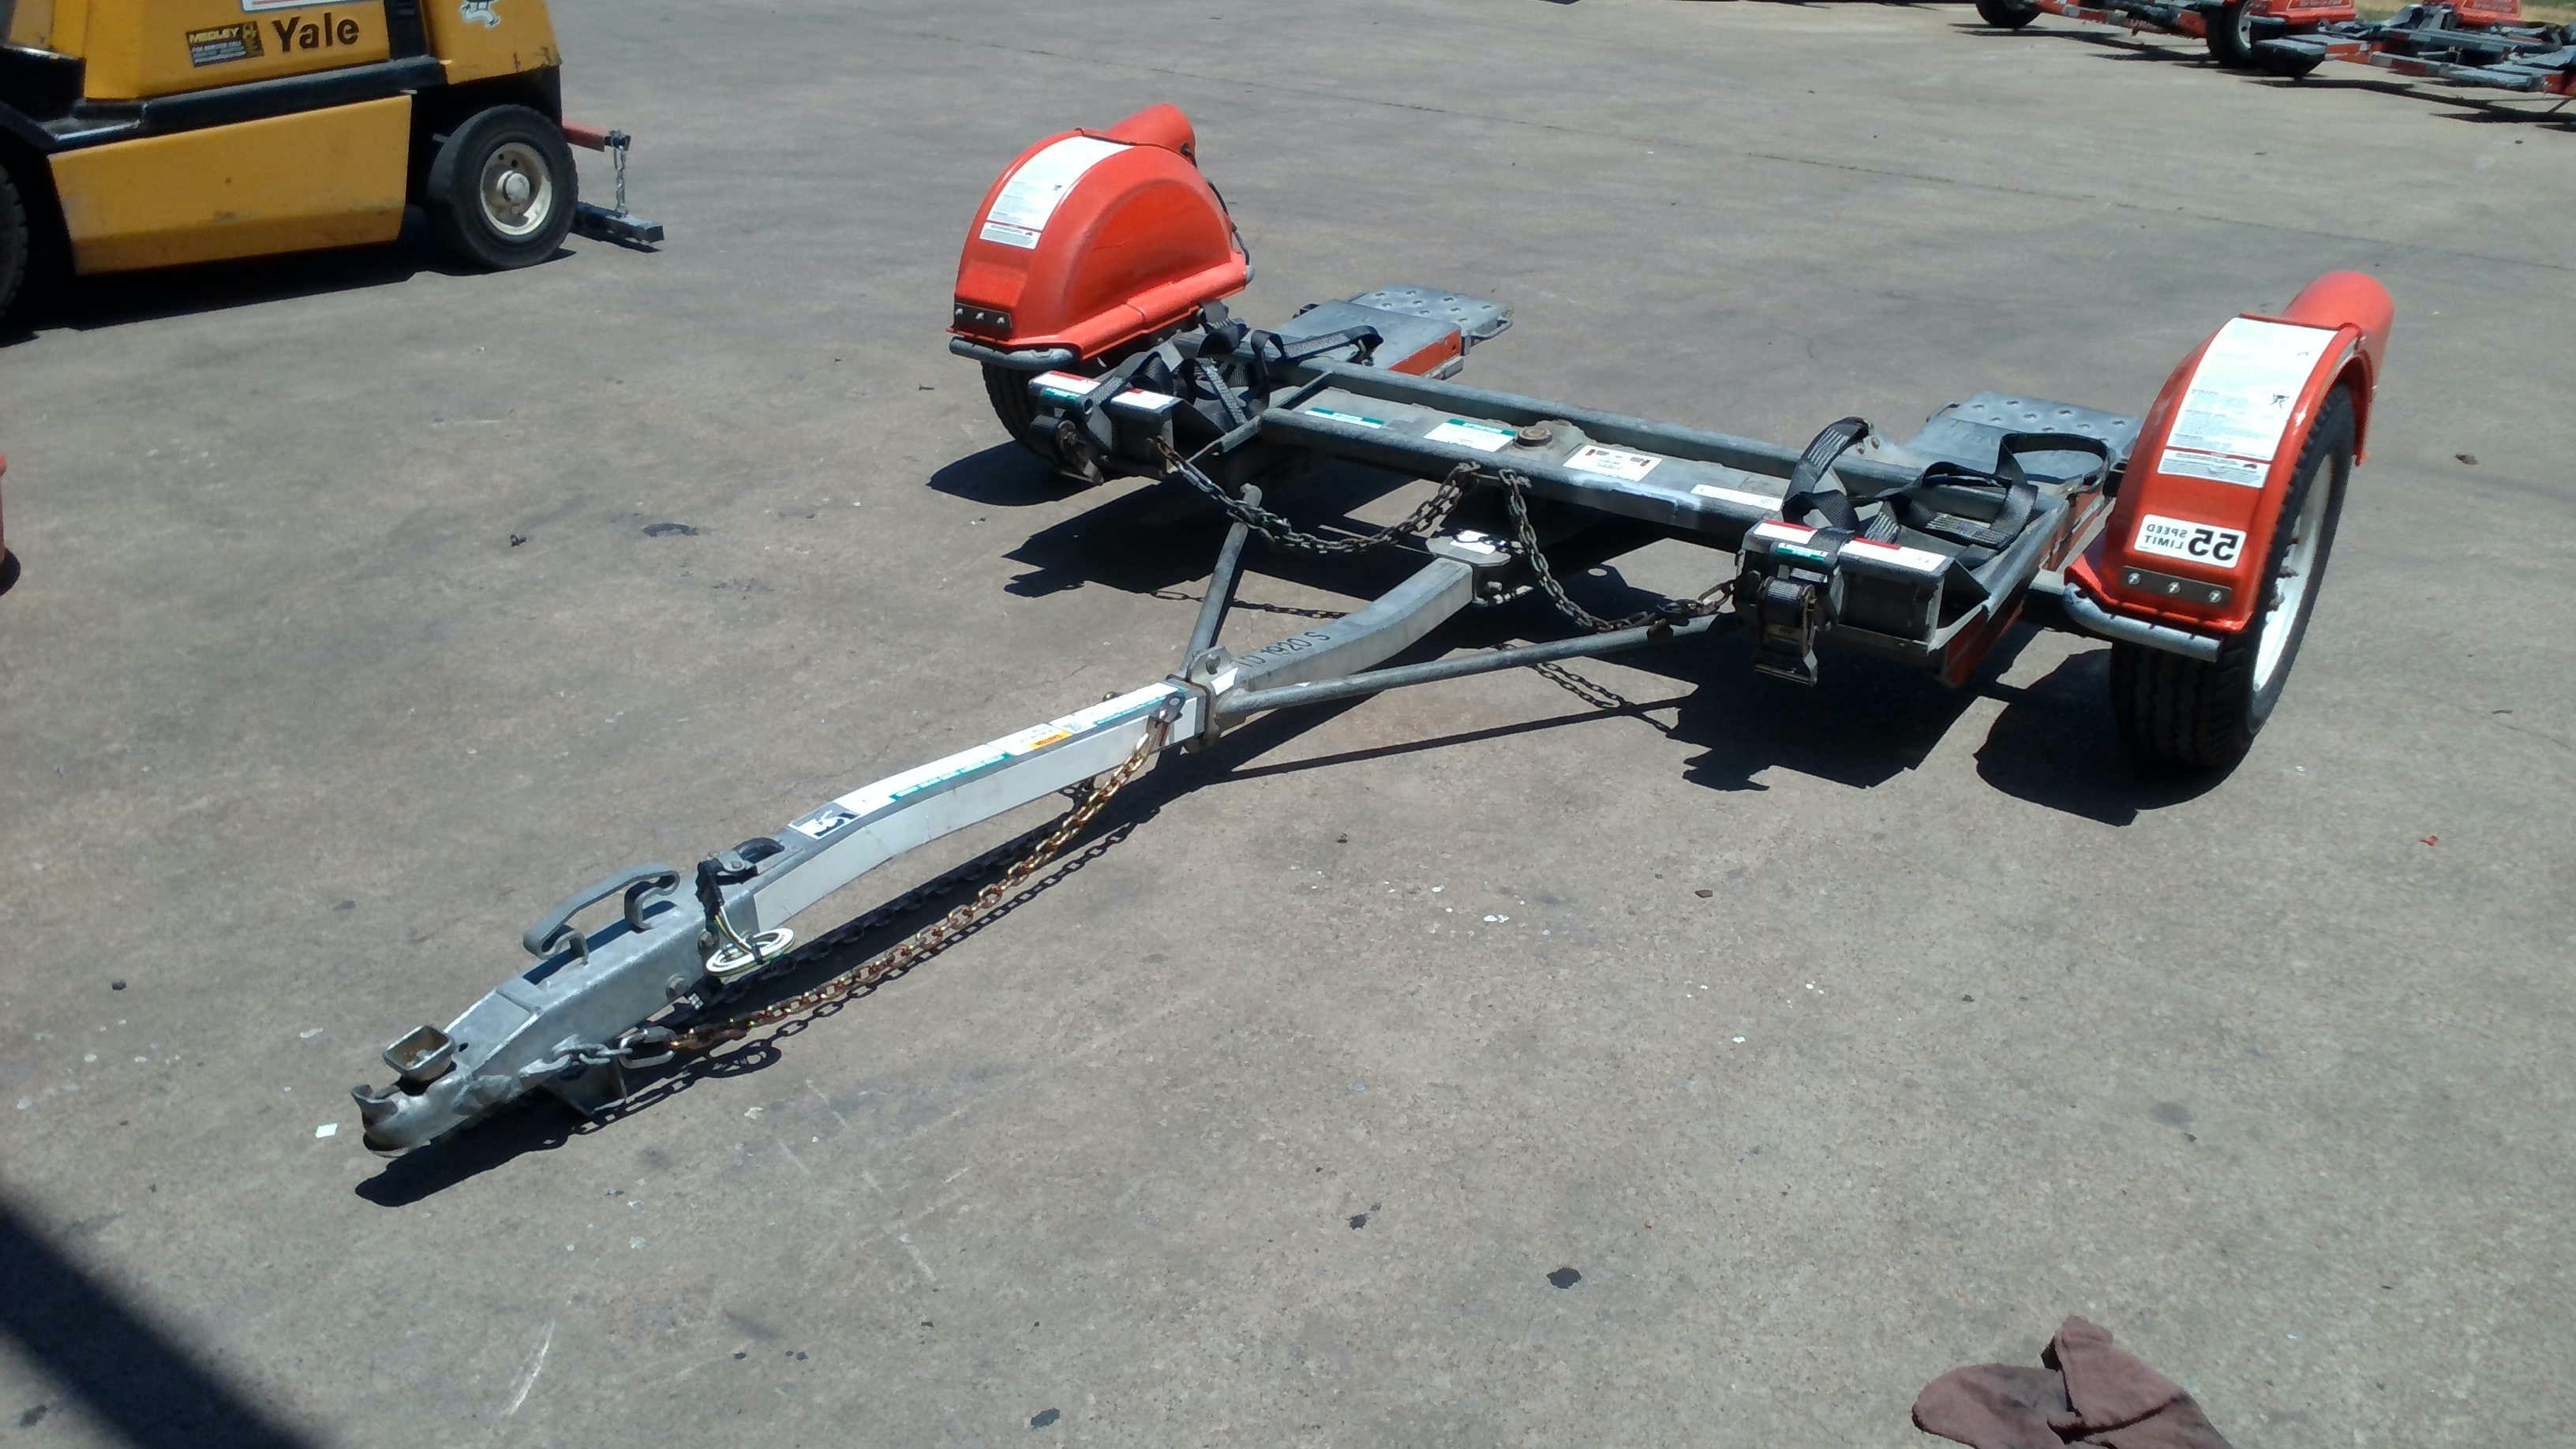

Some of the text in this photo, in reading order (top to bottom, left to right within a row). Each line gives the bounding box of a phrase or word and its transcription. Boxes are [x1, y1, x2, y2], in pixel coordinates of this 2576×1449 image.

[271, 13, 360, 52] Yale
[1260, 638, 1312, 655] 1920
[1303, 631, 1331, 641] S
